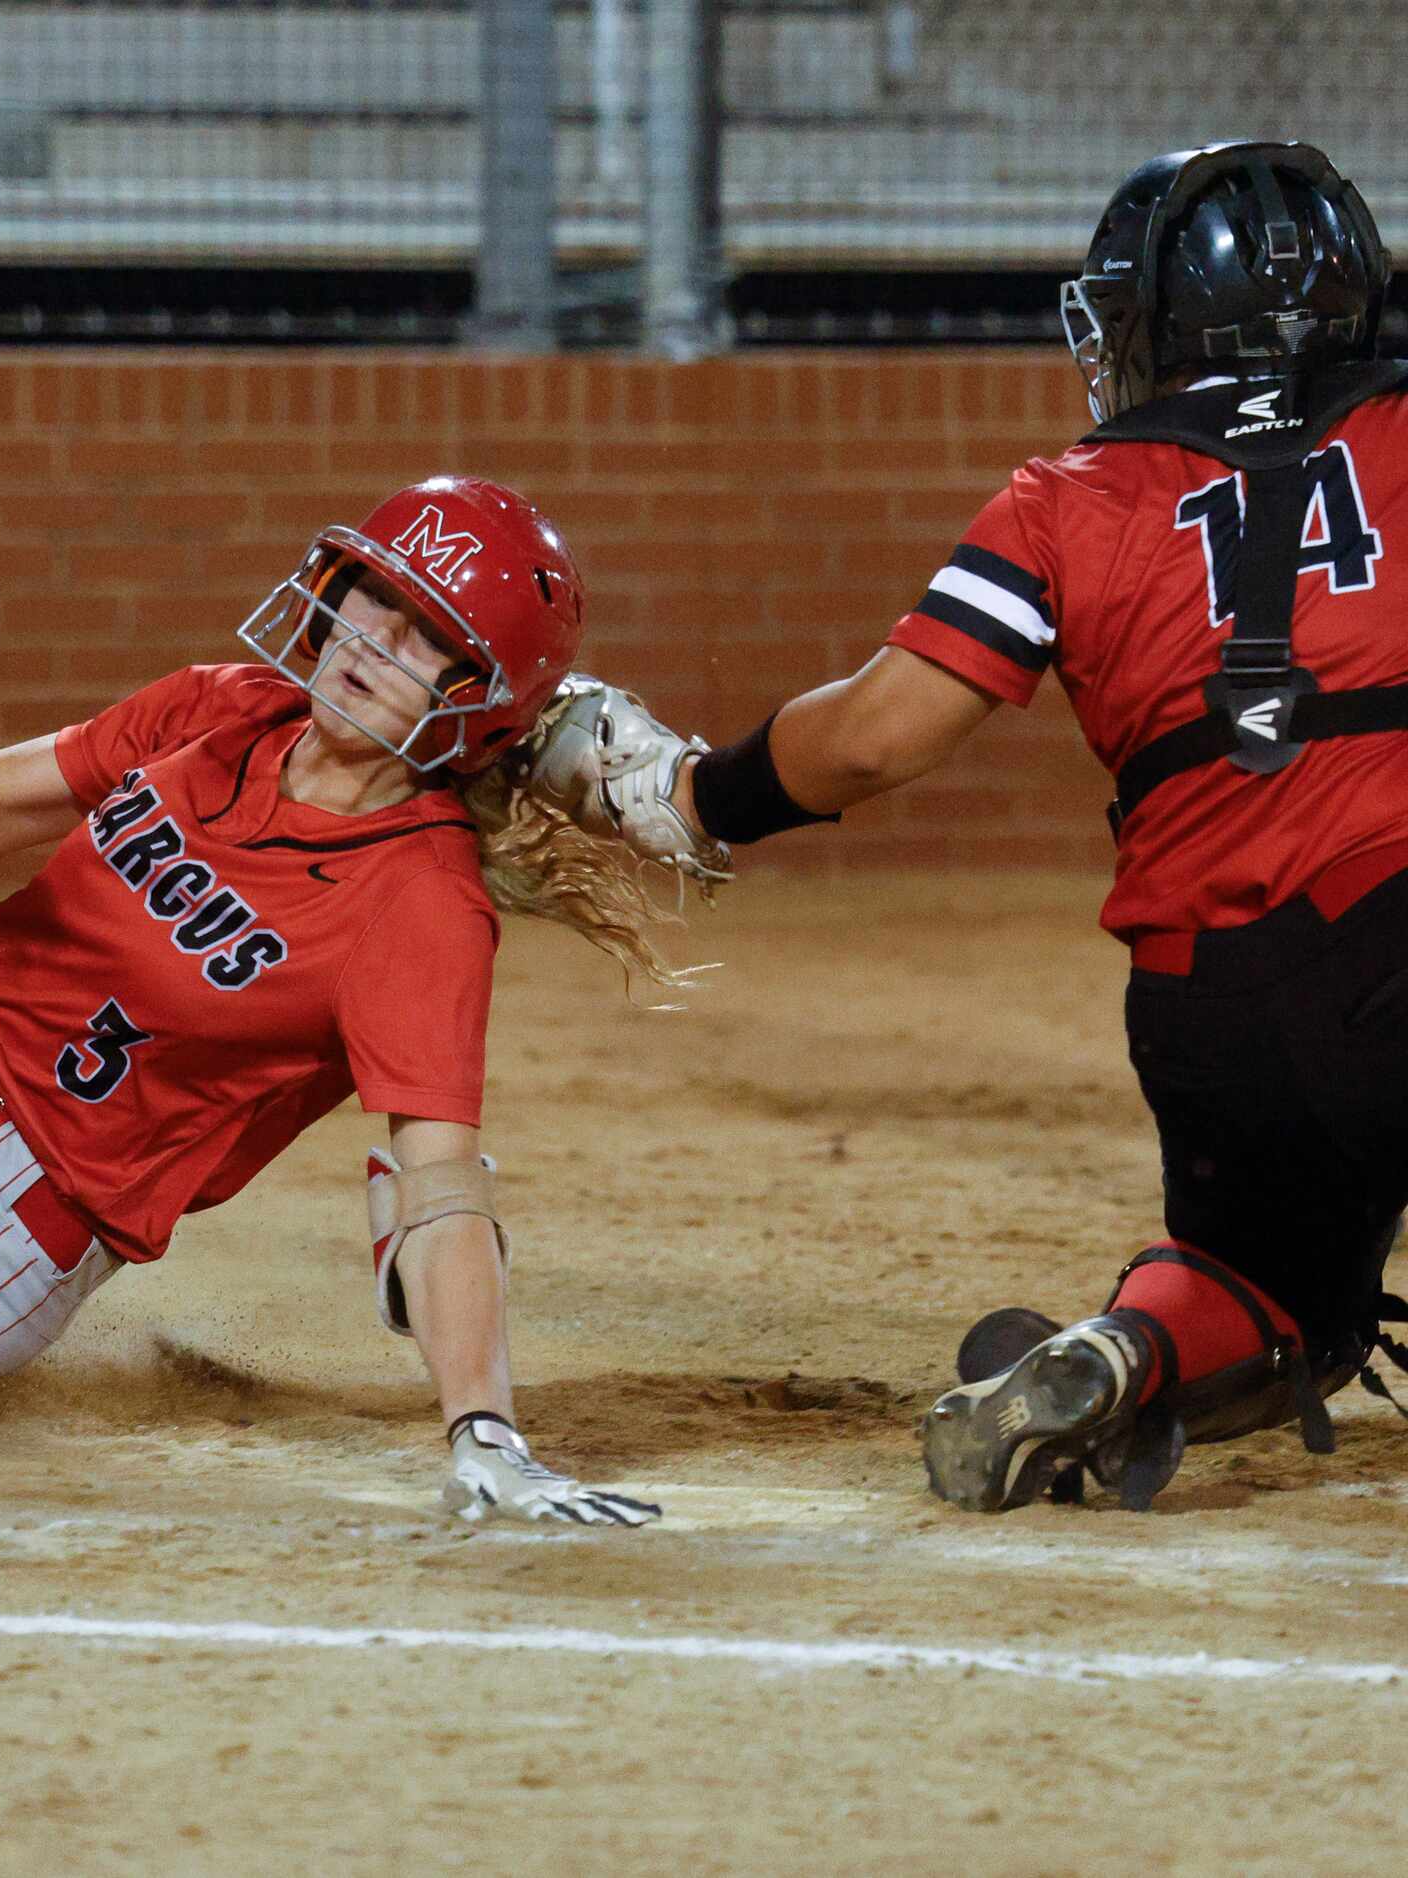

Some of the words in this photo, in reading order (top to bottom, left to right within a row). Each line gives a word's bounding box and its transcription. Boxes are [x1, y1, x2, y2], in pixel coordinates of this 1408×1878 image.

[1224, 418, 1304, 439] EASTON
[391, 504, 483, 587] M
[1173, 439, 1384, 629] 14
[55, 997, 154, 1104] 3
